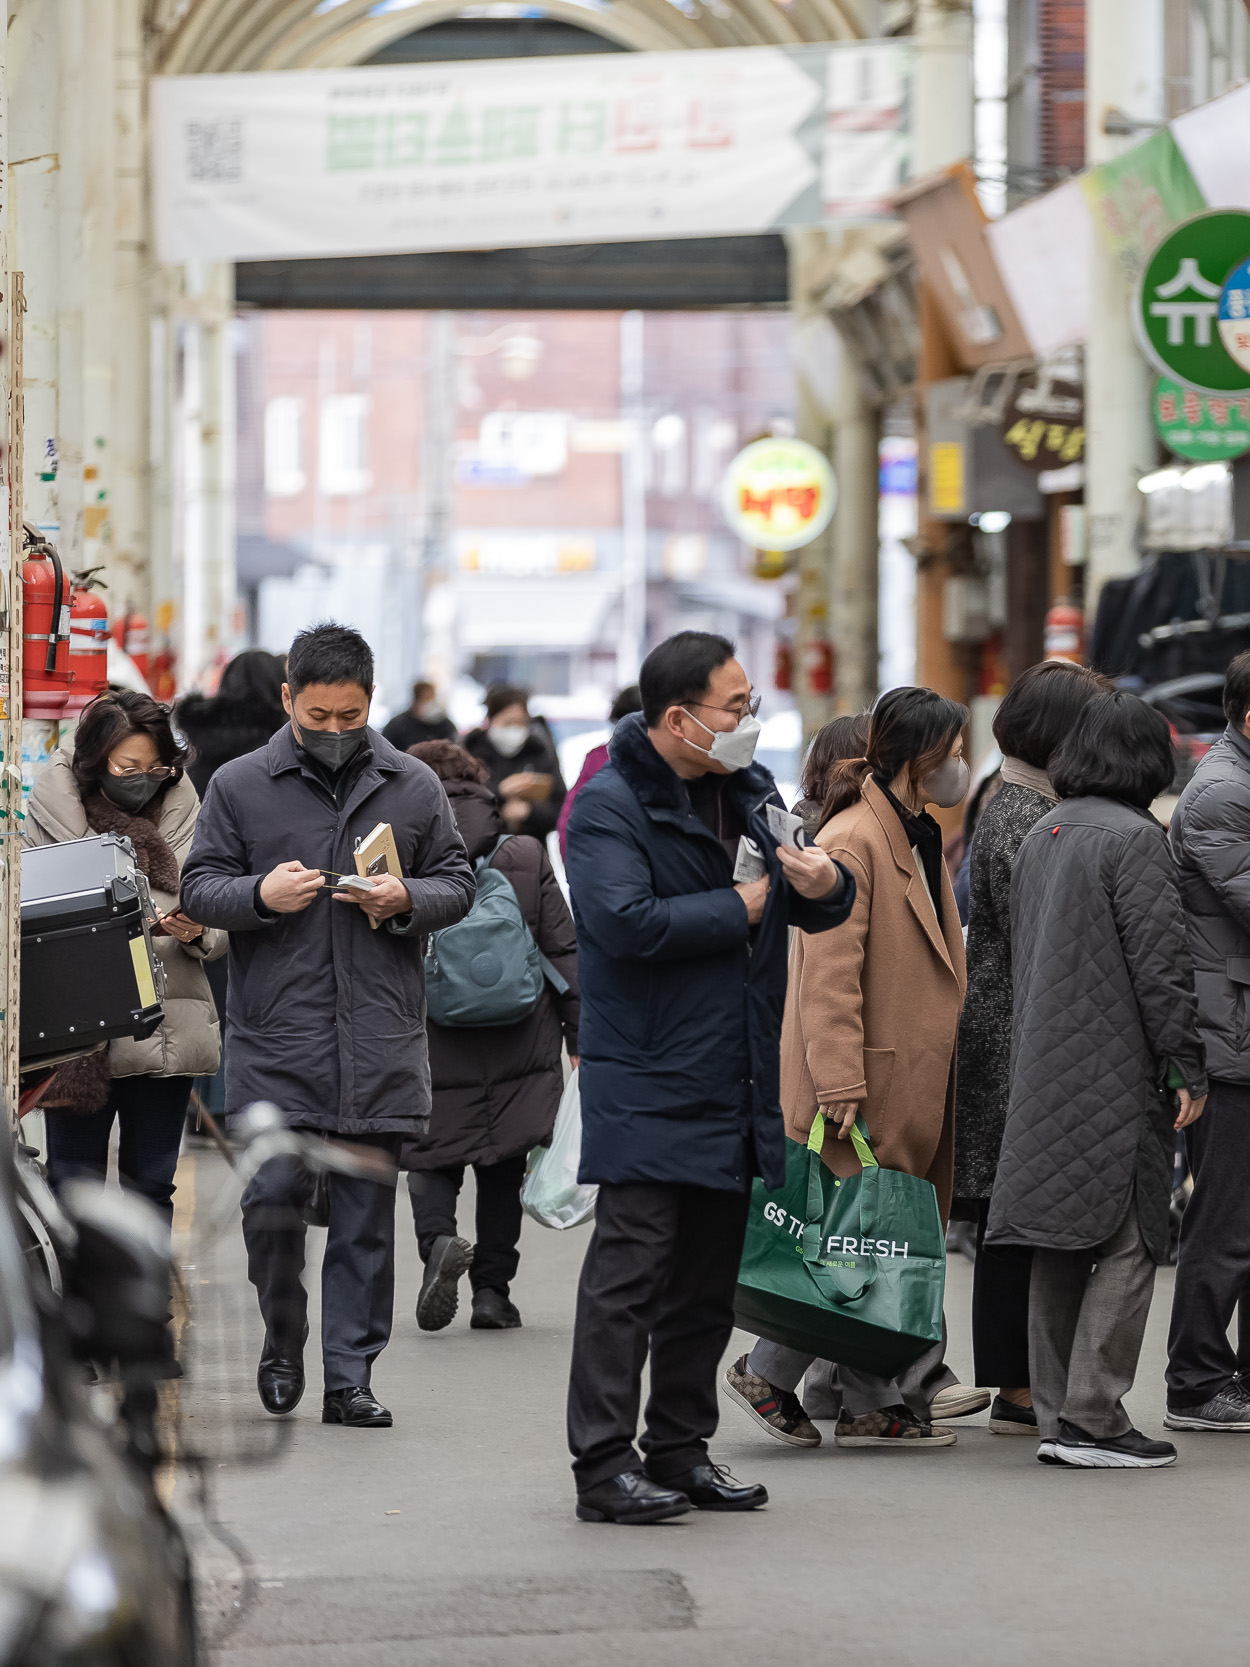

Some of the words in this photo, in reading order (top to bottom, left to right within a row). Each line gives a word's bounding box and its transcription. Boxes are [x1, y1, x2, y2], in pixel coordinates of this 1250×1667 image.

[763, 1202, 788, 1227] GS
[826, 1236, 909, 1259] FRESH
[826, 1260, 844, 1268] 새로운
[844, 1261, 856, 1269] 이름
